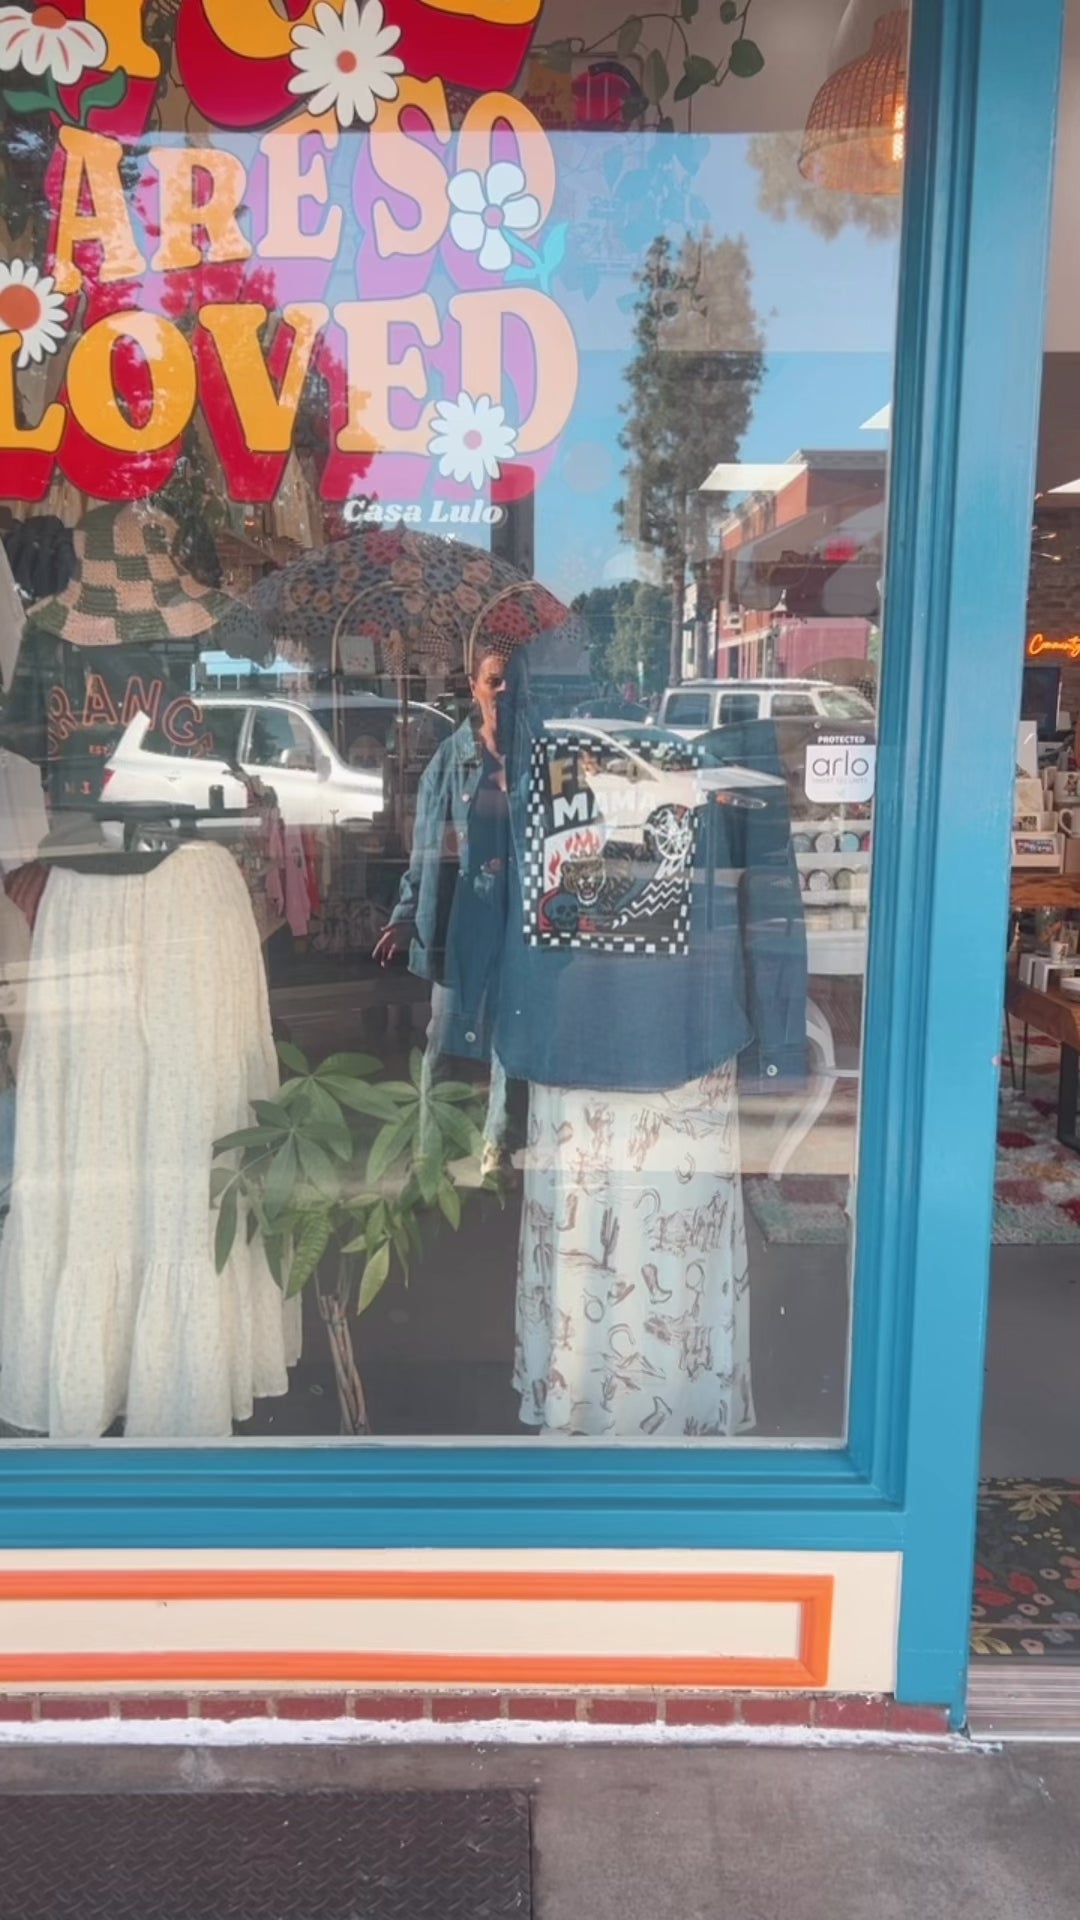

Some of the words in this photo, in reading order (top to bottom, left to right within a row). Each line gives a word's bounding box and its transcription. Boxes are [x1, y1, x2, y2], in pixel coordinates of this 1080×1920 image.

[50, 118, 343, 294] ARE
[371, 75, 556, 259] SO
[0, 289, 579, 454] LOVED
[343, 500, 422, 524] Casa
[429, 499, 504, 524] Lulo
[817, 735, 866, 744] PROTECTED
[813, 750, 869, 776] arlo
